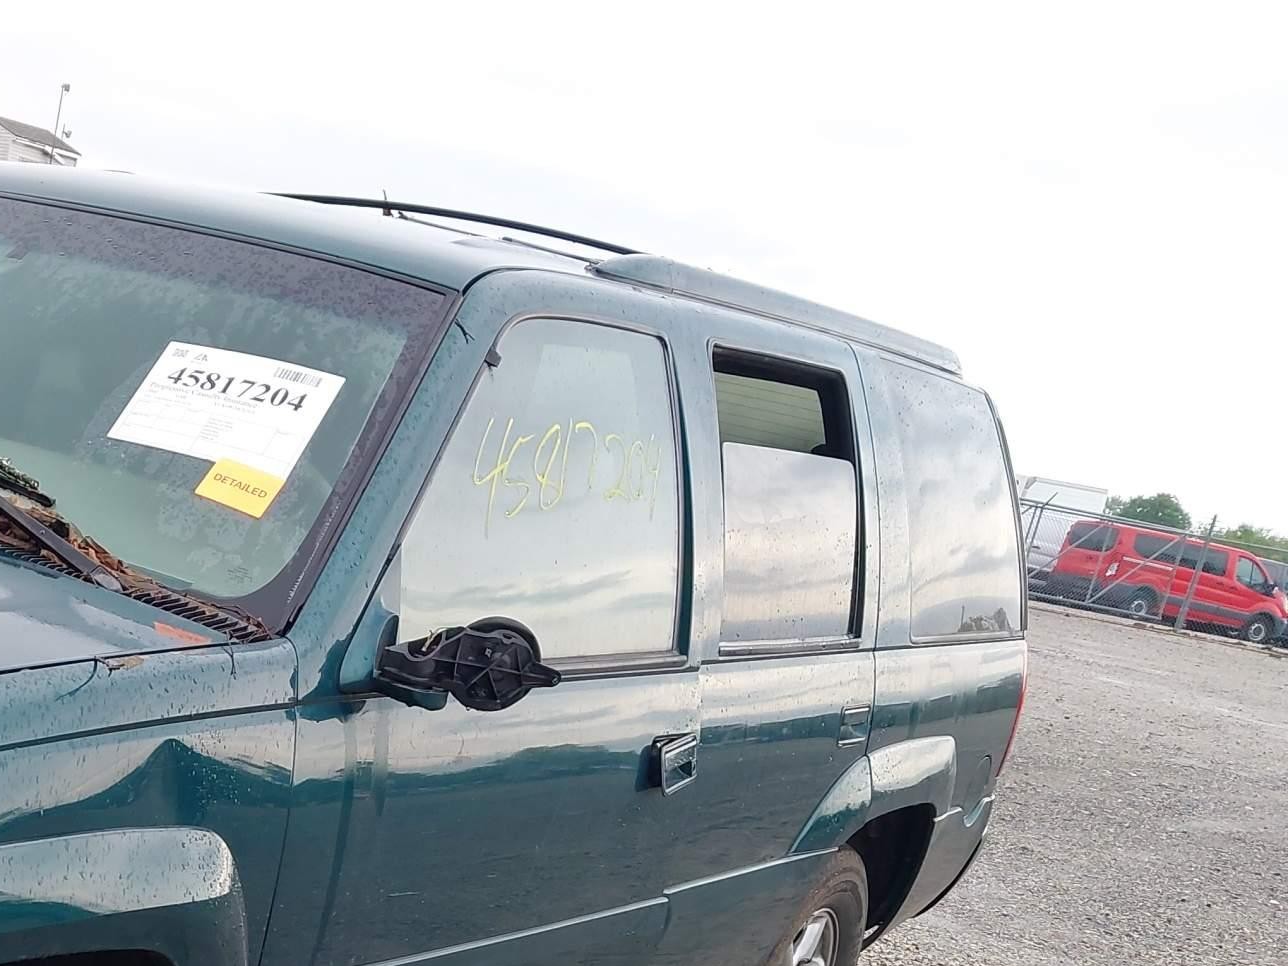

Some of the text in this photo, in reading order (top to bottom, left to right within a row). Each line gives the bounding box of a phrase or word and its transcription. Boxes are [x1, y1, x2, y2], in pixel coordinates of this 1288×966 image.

[167, 367, 308, 412] 45817204
[212, 471, 268, 501] DETAILED
[471, 416, 663, 539] 45817204
